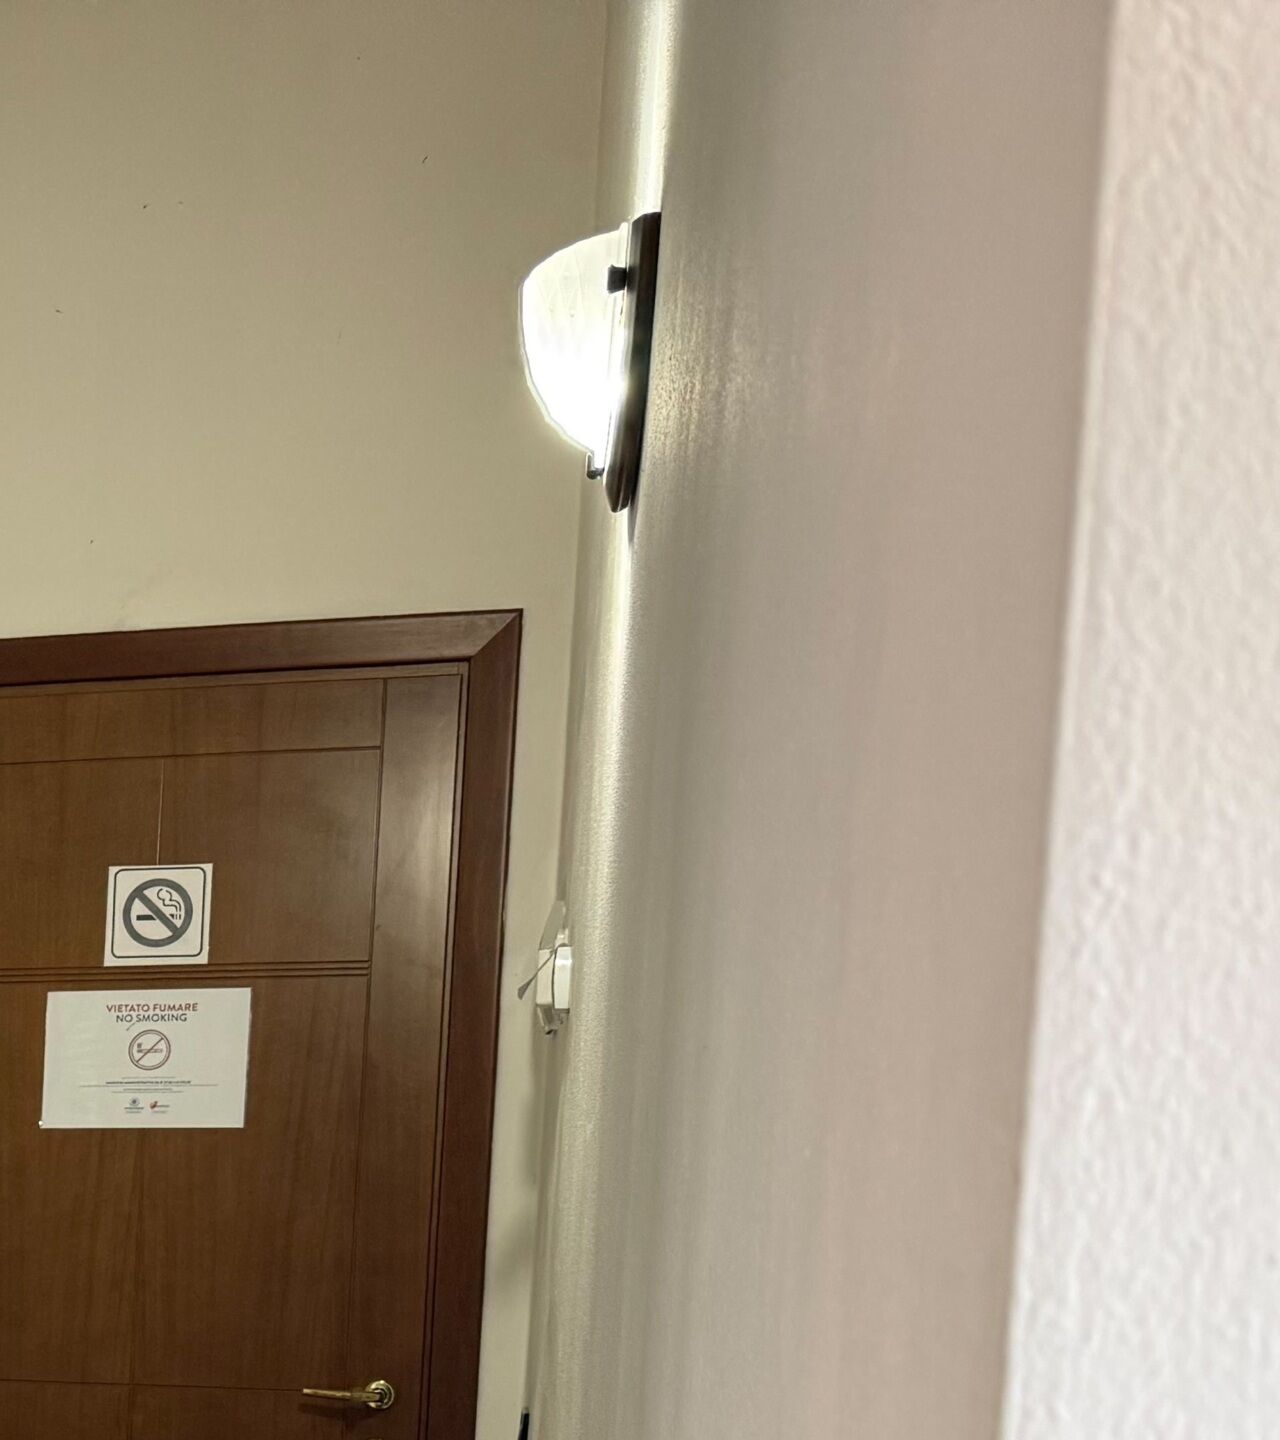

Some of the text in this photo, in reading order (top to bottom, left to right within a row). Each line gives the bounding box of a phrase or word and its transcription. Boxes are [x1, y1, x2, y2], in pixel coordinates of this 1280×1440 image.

[106, 1002, 198, 1013] VIETATO FUMARE
[116, 1012, 188, 1023] NO SMOKING
